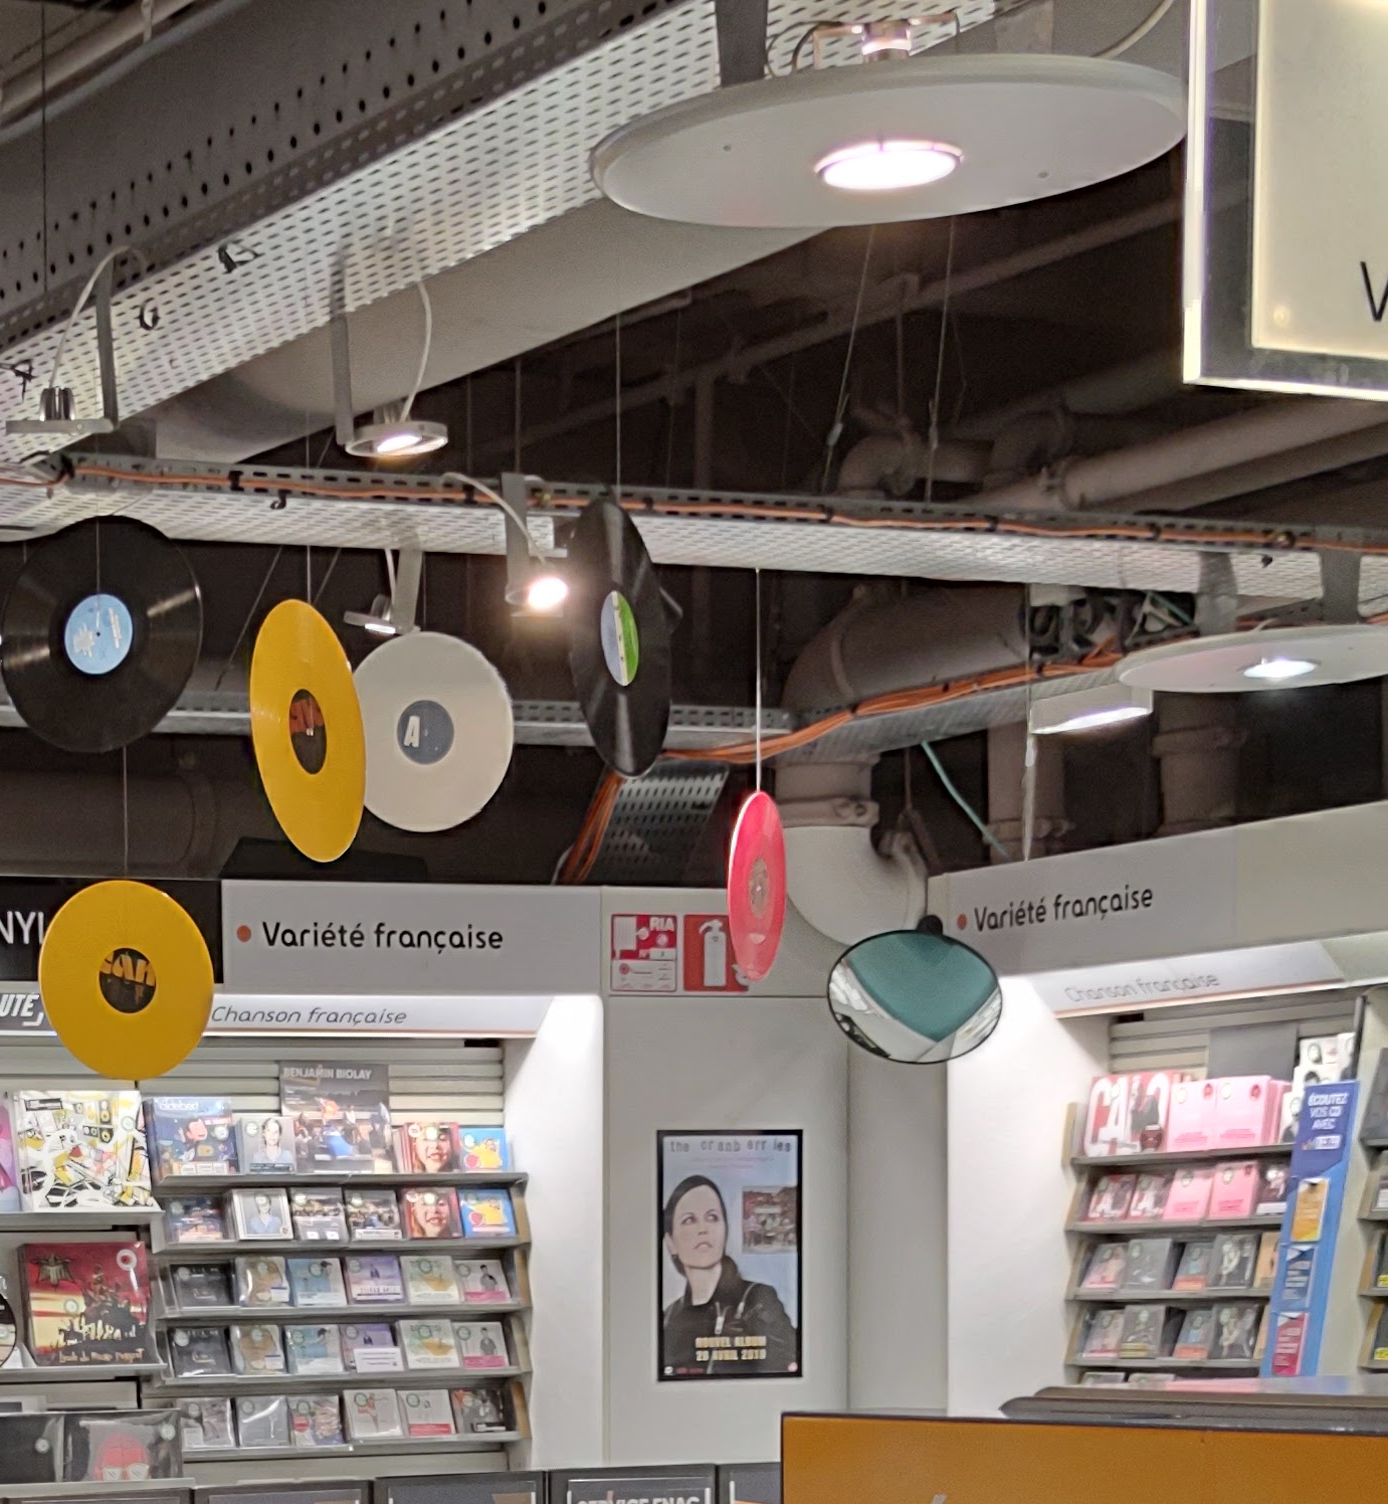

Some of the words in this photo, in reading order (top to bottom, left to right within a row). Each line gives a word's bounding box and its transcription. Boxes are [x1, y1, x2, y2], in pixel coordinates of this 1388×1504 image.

[974, 898, 1047, 933] Variété
[1053, 884, 1154, 925] française
[649, 916, 675, 933] RIA
[262, 921, 366, 949] Variété
[373, 921, 504, 955] française
[211, 1006, 302, 1025] Chanson
[307, 1006, 407, 1028] française
[283, 1066, 334, 1080] BENJAMIN
[336, 1068, 372, 1081] BIOLAY
